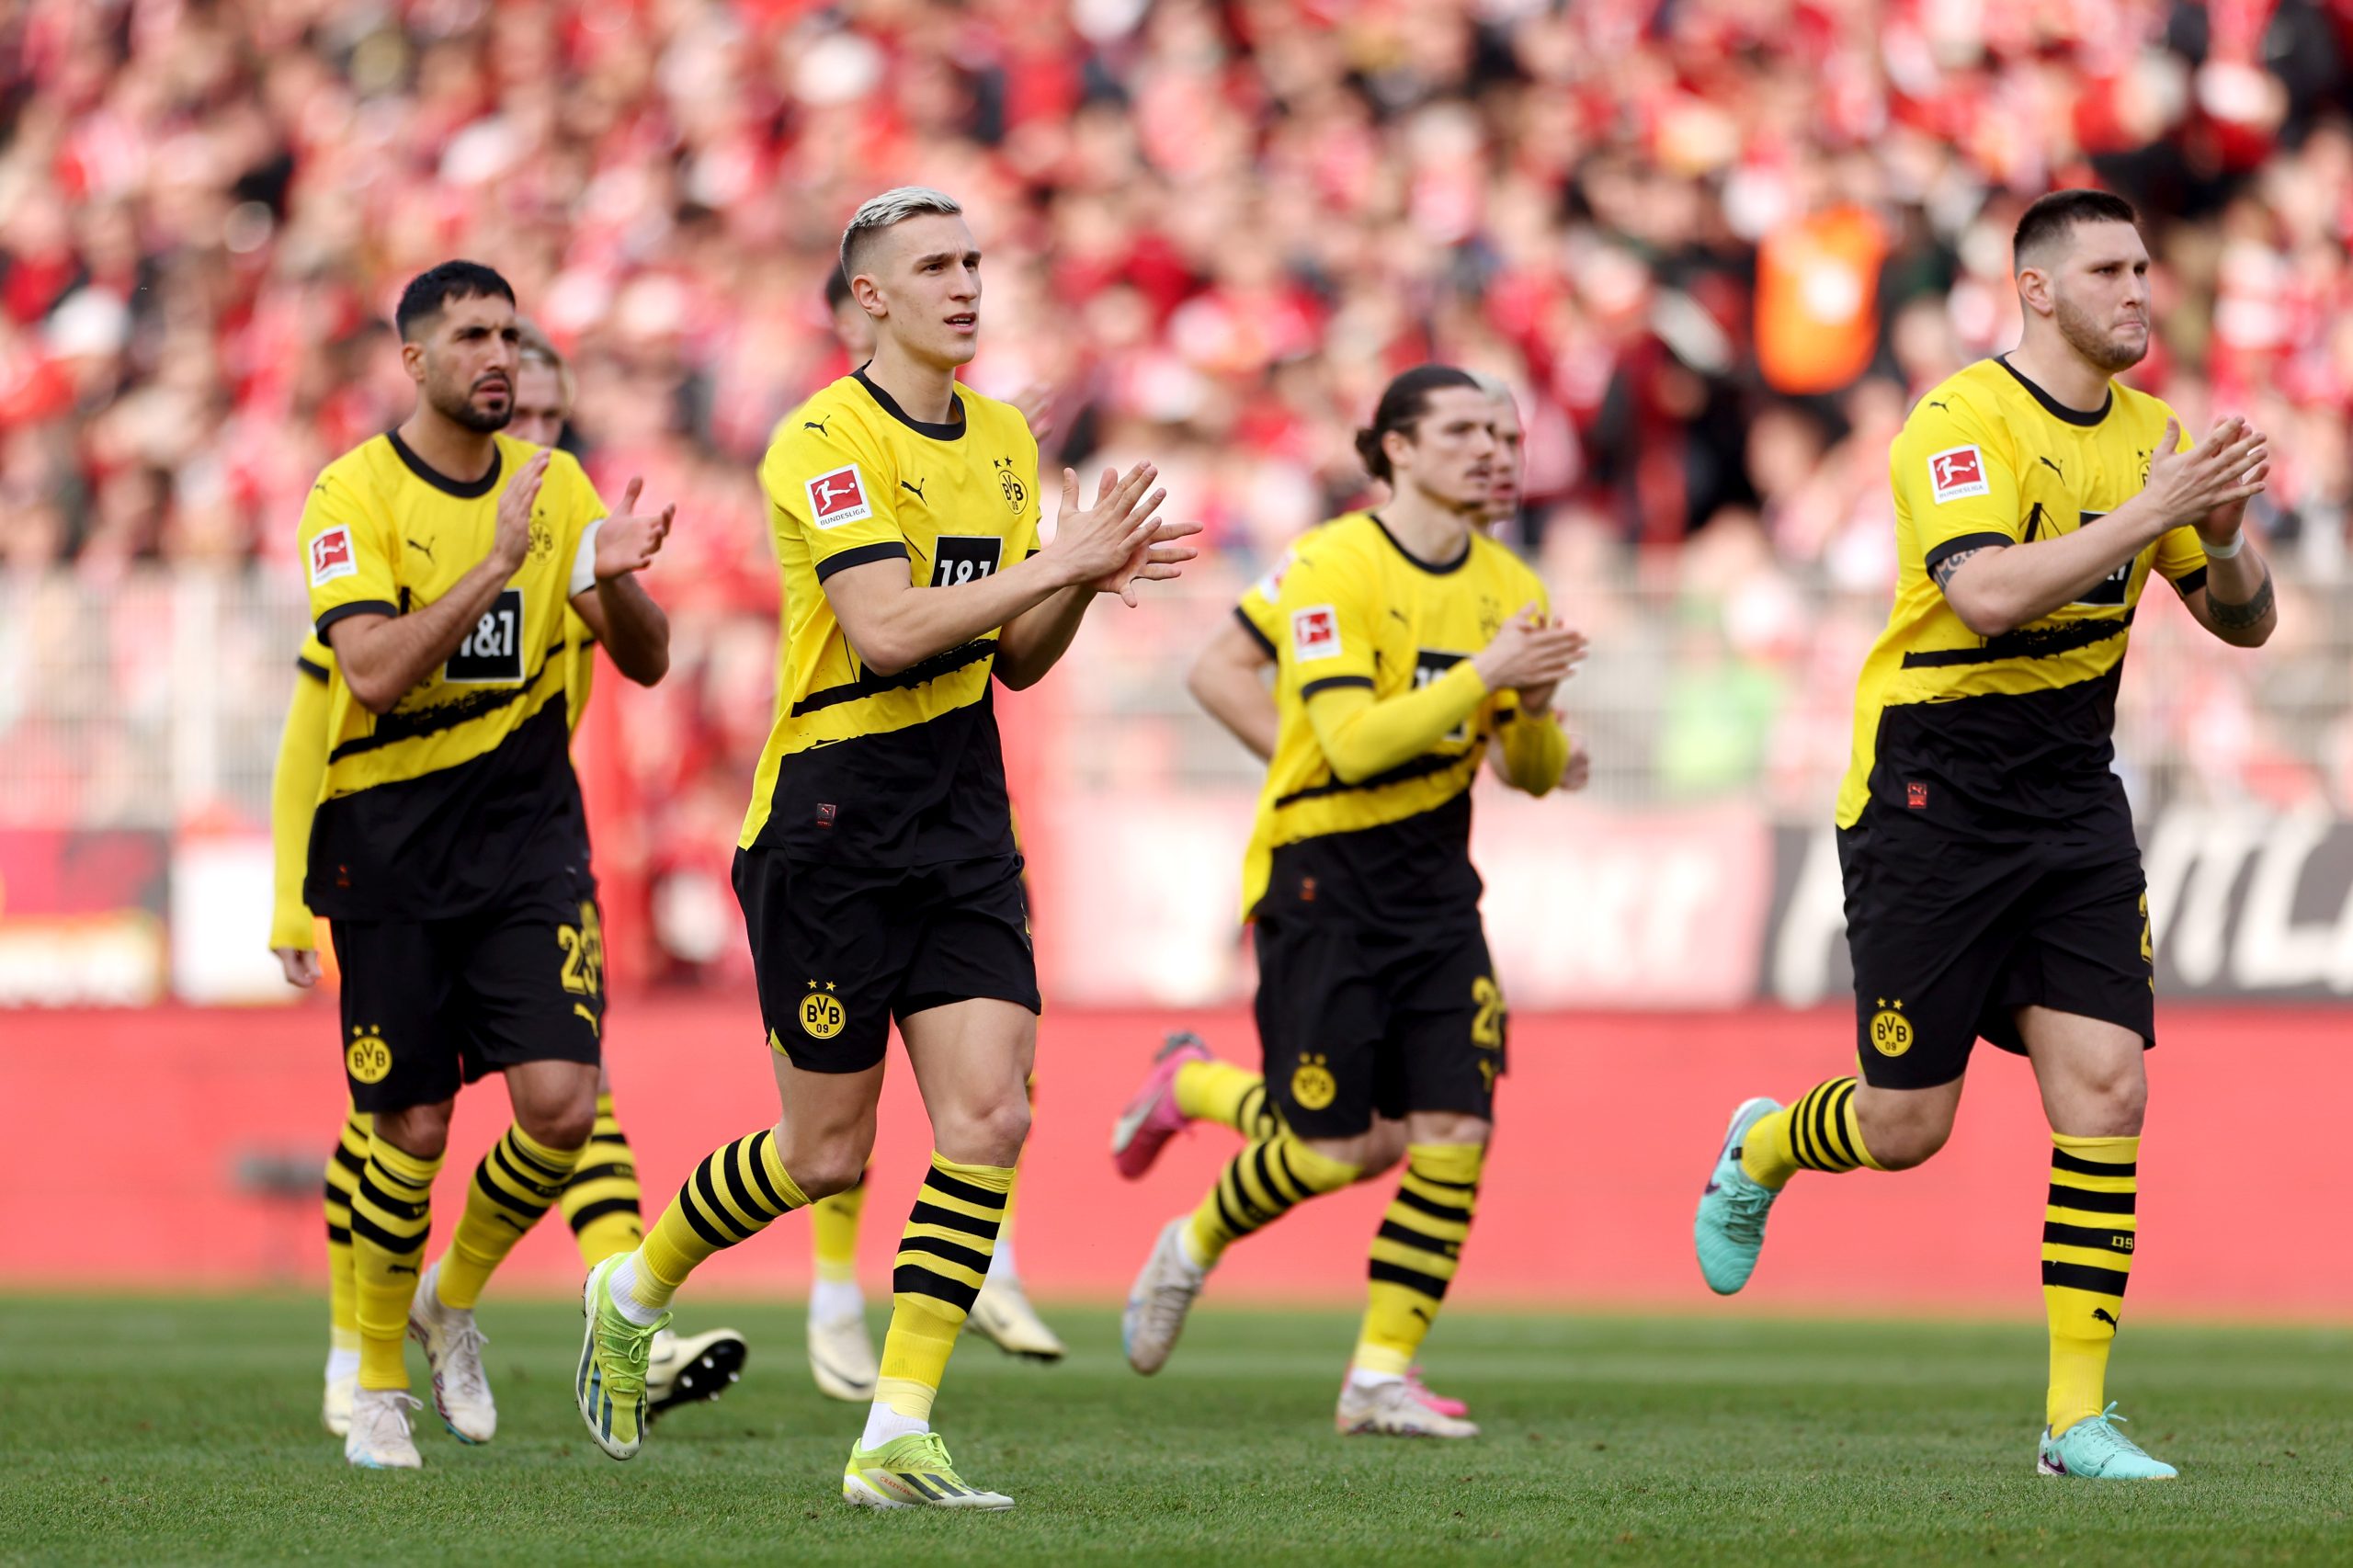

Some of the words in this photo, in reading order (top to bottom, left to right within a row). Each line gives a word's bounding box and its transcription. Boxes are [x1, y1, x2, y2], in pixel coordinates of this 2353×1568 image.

[1001, 474, 1024, 501] BVB
[820, 507, 866, 526] BUNDESLIGA
[807, 996, 840, 1025] BVB
[816, 1023, 829, 1034] 09
[1877, 1015, 1907, 1043] BVB
[354, 1042, 386, 1068] BVB
[1885, 1041, 1897, 1051] 09
[2111, 1235, 2134, 1250] 09
